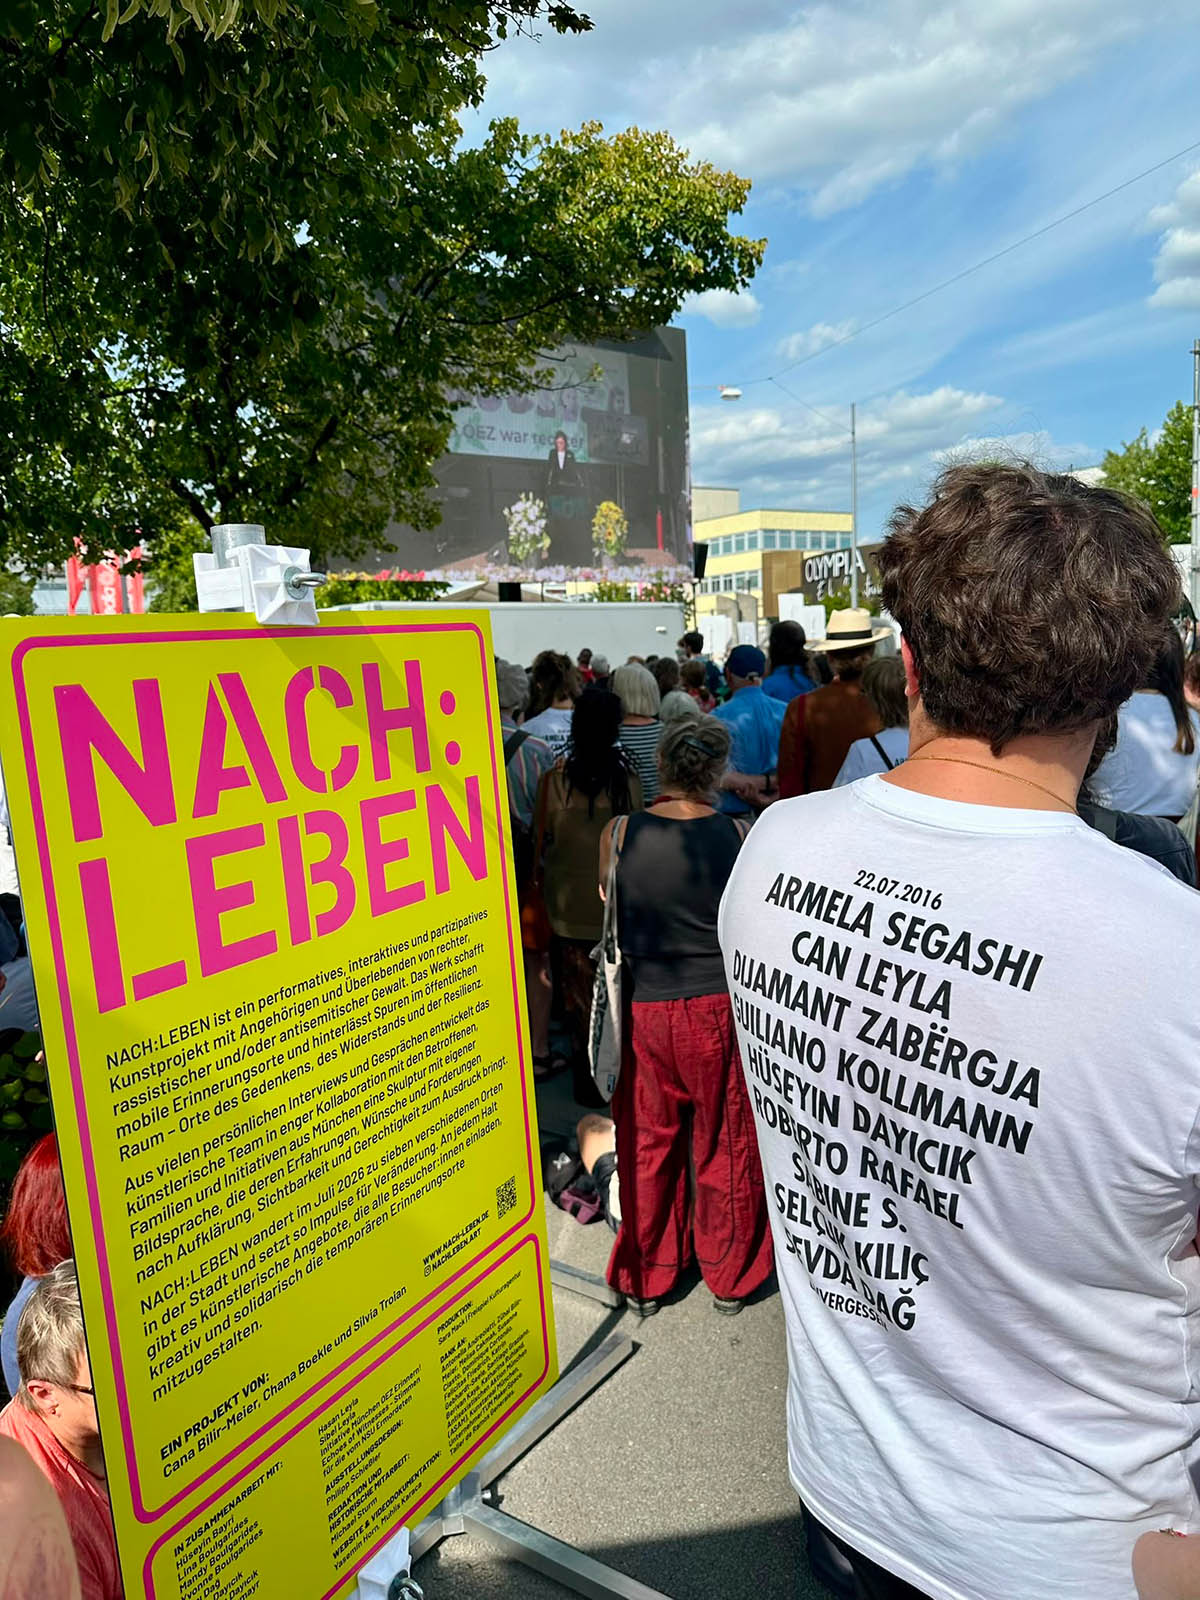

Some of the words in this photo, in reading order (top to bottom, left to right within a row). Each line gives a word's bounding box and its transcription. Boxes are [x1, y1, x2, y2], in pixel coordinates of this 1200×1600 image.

[462, 423, 496, 441] OEZ
[499, 431, 529, 444] war
[532, 431, 586, 449] recer
[805, 549, 866, 582] OLYMPIA
[53, 659, 461, 843] NACH:
[78, 775, 489, 1014] LEBEN
[765, 872, 876, 938] ARMELA
[883, 912, 1044, 992] SEGASHI
[854, 869, 943, 910] 22.07.2016
[106, 1015, 210, 1070] NACH:LEBEN
[213, 1009, 232, 1027] ist
[234, 1001, 255, 1019] ein
[258, 967, 346, 1013] performatives,
[348, 940, 410, 973] interaktives
[411, 930, 429, 948] und
[430, 909, 488, 943] partizipatives
[109, 1040, 210, 1094] Kunstprojekt
[213, 1029, 236, 1050] mit
[239, 996, 320, 1040] Angehörigen
[321, 983, 343, 1004] und
[345, 956, 417, 993] Überlebenden
[417, 948, 435, 963] von
[436, 934, 470, 955] rechter,
[113, 1063, 212, 1117] rassistischer
[215, 1035, 277, 1071] und/oder
[279, 994, 370, 1043] antisemitischer
[371, 977, 409, 1001] Gewalt.
[410, 969, 429, 985] Das
[429, 956, 453, 975] Werk
[454, 943, 485, 965] schafft
[116, 1106, 169, 1140] mobile
[172, 1053, 285, 1113] Erinnerungsorte
[287, 1038, 310, 1060] und
[312, 1011, 372, 1049] hinterlässt
[373, 996, 410, 1020] Spuren
[411, 989, 424, 1002] im
[424, 964, 478, 996] öffentlichen
[733, 949, 851, 1032] DIJAMANT
[856, 1006, 1041, 1107] ZABËRGJA
[792, 931, 853, 980] CAN
[856, 952, 952, 1019] LEYLA
[119, 1132, 165, 1162] Raum
[179, 1110, 211, 1133] Orte
[213, 1096, 239, 1117] des
[241, 1062, 314, 1103] Gedenkens,
[317, 1049, 338, 1067] des
[339, 1015, 406, 1055] Widerstands
[407, 1003, 425, 1023] und
[427, 998, 442, 1013] der
[443, 979, 484, 1005] Resilienz.
[124, 1170, 154, 1195] Aus
[156, 1147, 200, 1177] vielen
[202, 1103, 287, 1158] persönlichen
[288, 1072, 348, 1111] Interviews
[349, 1057, 370, 1079] und
[371, 1031, 429, 1067] Gesprächen
[429, 1006, 474, 1037] entwickelt
[475, 999, 490, 1013] das
[126, 1157, 226, 1217] künstlerische
[227, 1136, 264, 1162] Team
[265, 1129, 278, 1144] in
[280, 1109, 314, 1136] enger
[316, 1071, 387, 1117] Kollaboration
[388, 1060, 405, 1078] mit
[406, 1051, 424, 1068] den
[424, 1023, 478, 1058] Betroffenen,
[130, 1197, 193, 1239] Familien
[195, 1177, 222, 1203] und
[224, 1145, 287, 1188] Initiativen
[289, 1132, 311, 1152] aus
[312, 1104, 362, 1139] München
[363, 1091, 385, 1110] eine
[386, 1067, 427, 1097] Skulptur
[428, 1057, 444, 1074] mit
[444, 1040, 476, 1065] eigener
[734, 993, 826, 1072] GUILIANO
[838, 1048, 1034, 1154] KOLLMANN
[748, 1043, 840, 1127] HÜSEYIN
[853, 1101, 977, 1184] DAYICIK
[140, 1243, 239, 1315] NACH:LEBEN
[241, 1210, 295, 1252] wandert
[296, 1202, 312, 1219] im
[313, 1184, 335, 1208] Juli
[336, 1166, 365, 1194] 2026
[366, 1160, 379, 1176] zu
[380, 1139, 414, 1166] sieben
[415, 1097, 480, 1144] verschiedenen
[480, 1082, 503, 1103] Orten
[143, 1320, 158, 1337] in
[161, 1300, 186, 1325] der
[189, 1273, 229, 1307] Stadt
[231, 1254, 256, 1281] und
[258, 1234, 291, 1263] setzt
[293, 1225, 308, 1242] so
[309, 1195, 354, 1231] Impulse
[356, 1183, 372, 1201] für
[373, 1143, 439, 1188] Veränderung.
[440, 1132, 453, 1147] An
[453, 1114, 480, 1142] jedem
[481, 1101, 498, 1120] Halt
[147, 1328, 177, 1362] gibt
[180, 1318, 198, 1336] es
[200, 1257, 290, 1324] künstlerische
[293, 1219, 351, 1263] Angebote,
[353, 1205, 370, 1222] die
[372, 1191, 390, 1210] alle
[391, 1142, 465, 1197] Besucher:innen
[465, 1118, 502, 1147] einladen,
[792, 1152, 870, 1228] SABINE
[881, 1197, 908, 1233] S.
[855, 1241, 930, 1286] KILIÇ
[860, 1145, 965, 1230] RAFAEL
[149, 1336, 201, 1381] kreativ
[204, 1314, 231, 1343] und
[233, 1268, 303, 1323] solidarisch
[305, 1256, 323, 1274] die
[325, 1211, 389, 1261] temporären
[390, 1159, 465, 1217] Erinnerungsorte
[809, 1281, 889, 1332] VERGESSEN
[860, 1278, 916, 1331] DAĞ
[152, 1320, 263, 1402] mitzugestalten.
[160, 1435, 182, 1461] EIN
[183, 1391, 240, 1443] PROJEKT
[242, 1373, 270, 1398] VON:
[163, 1448, 196, 1478] Cana
[197, 1399, 261, 1453] Bilir-Meier,
[262, 1371, 297, 1401] Chana
[297, 1343, 333, 1375] Boekle
[334, 1325, 352, 1347] und
[353, 1308, 378, 1332] Silvia
[379, 1286, 407, 1312] Troian
